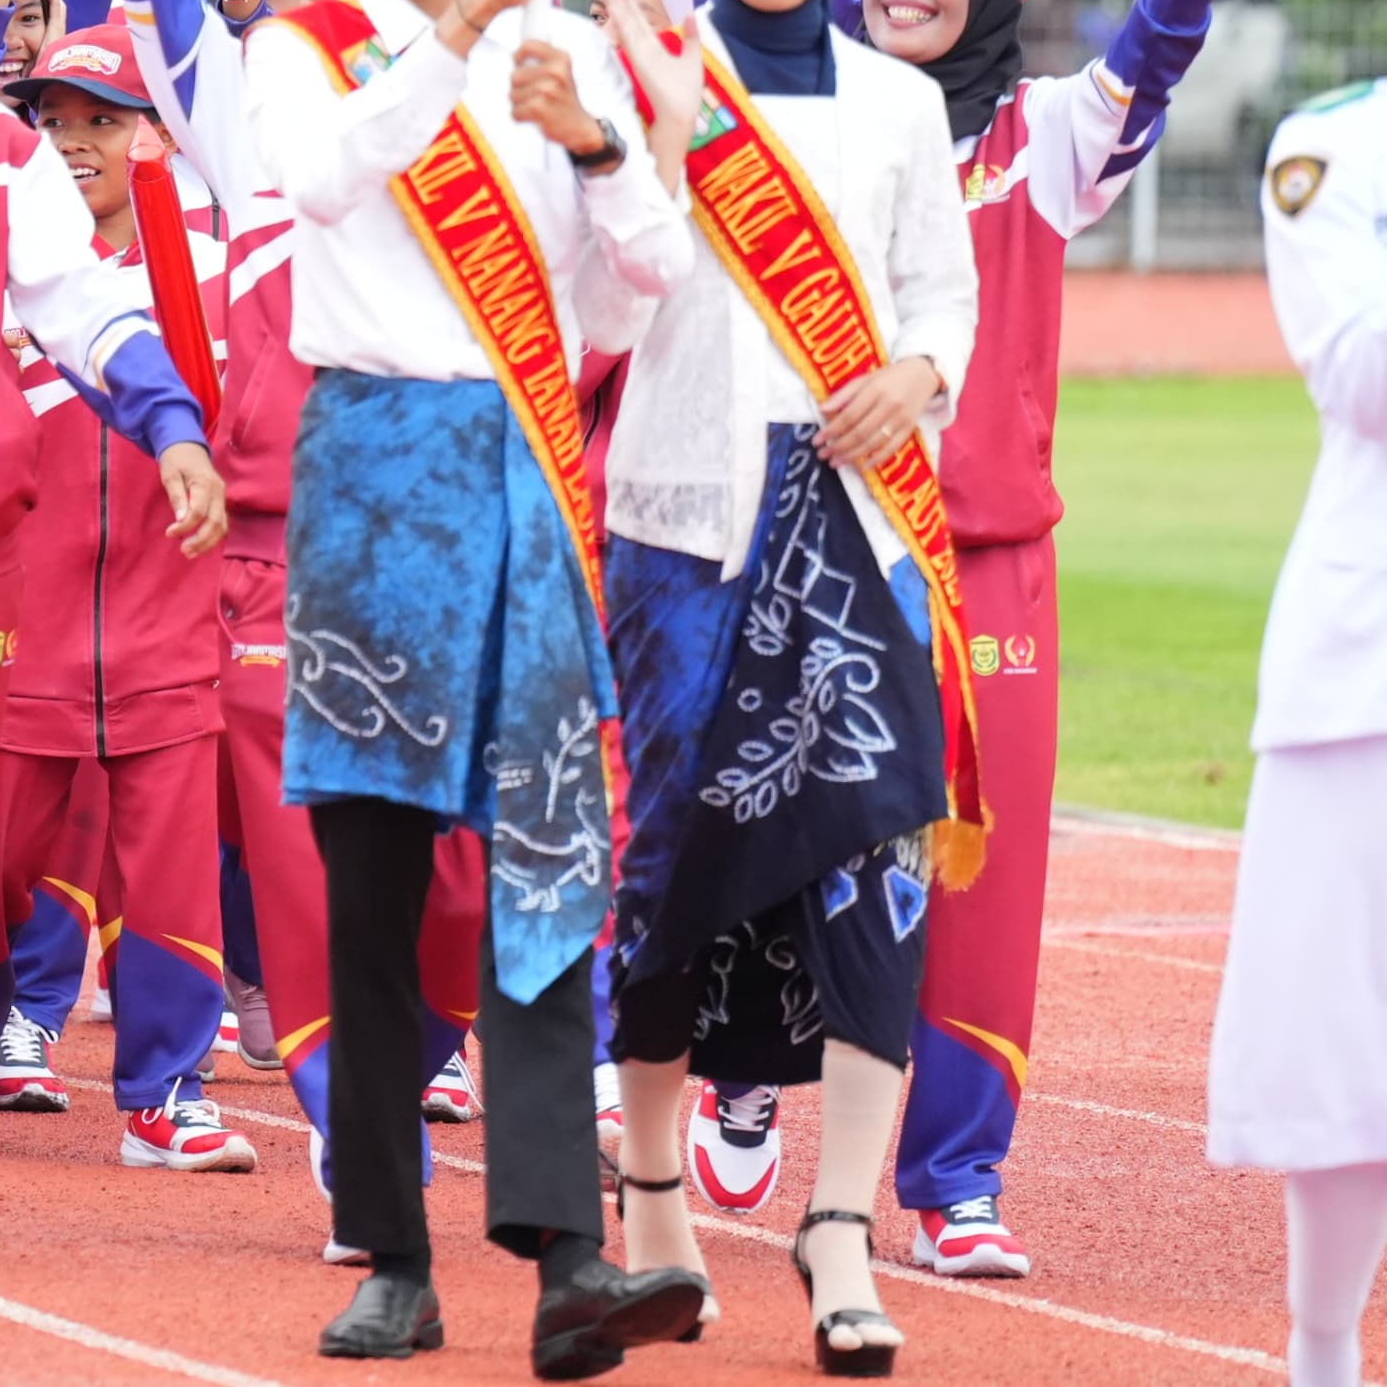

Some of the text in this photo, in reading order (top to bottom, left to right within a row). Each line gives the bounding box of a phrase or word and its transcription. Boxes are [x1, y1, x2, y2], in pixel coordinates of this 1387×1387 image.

[436, 184, 500, 232] V
[697, 140, 874, 390] WAKIL V GALUH
[450, 220, 556, 366] NANANG
[524, 351, 584, 467] TANAH
